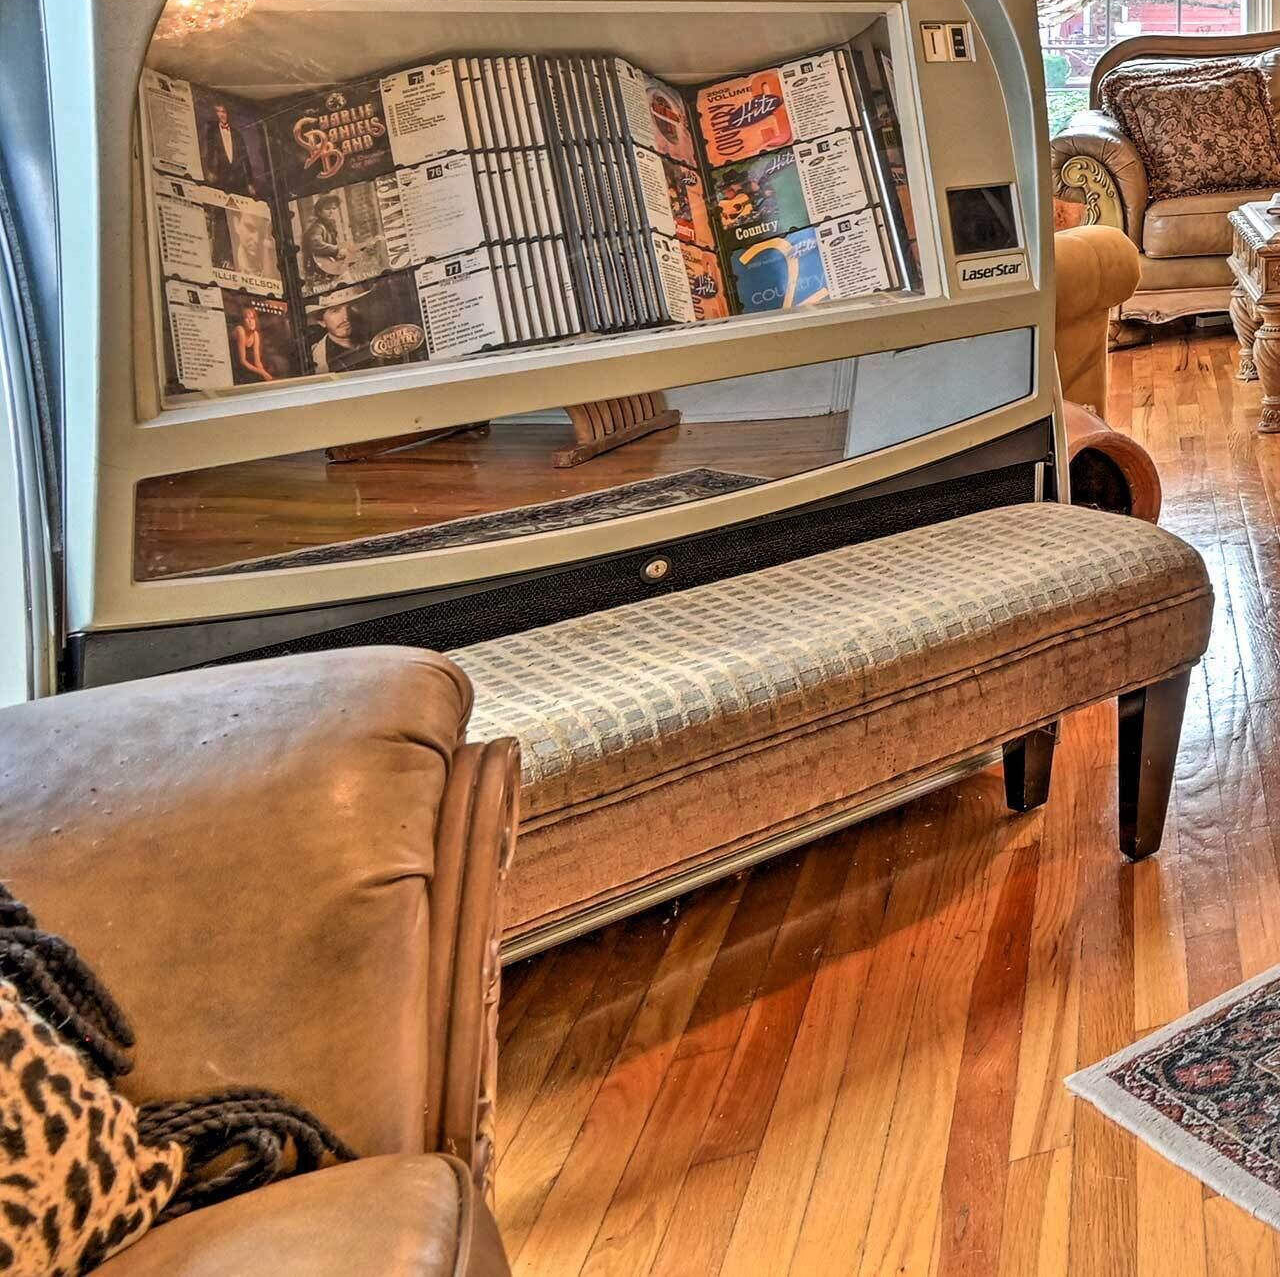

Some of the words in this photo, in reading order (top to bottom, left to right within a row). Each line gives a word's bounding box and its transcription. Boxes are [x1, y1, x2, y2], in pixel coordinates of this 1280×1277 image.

[707, 85, 752, 103] VOLUME
[731, 94, 778, 126] Hitz
[429, 168, 442, 177] 76
[765, 152, 795, 174] Hitz
[736, 220, 778, 240] Country
[447, 264, 460, 275] 77
[962, 262, 1022, 282] LaserStar
[212, 270, 237, 282] ILLIE
[241, 277, 280, 290] NELSON
